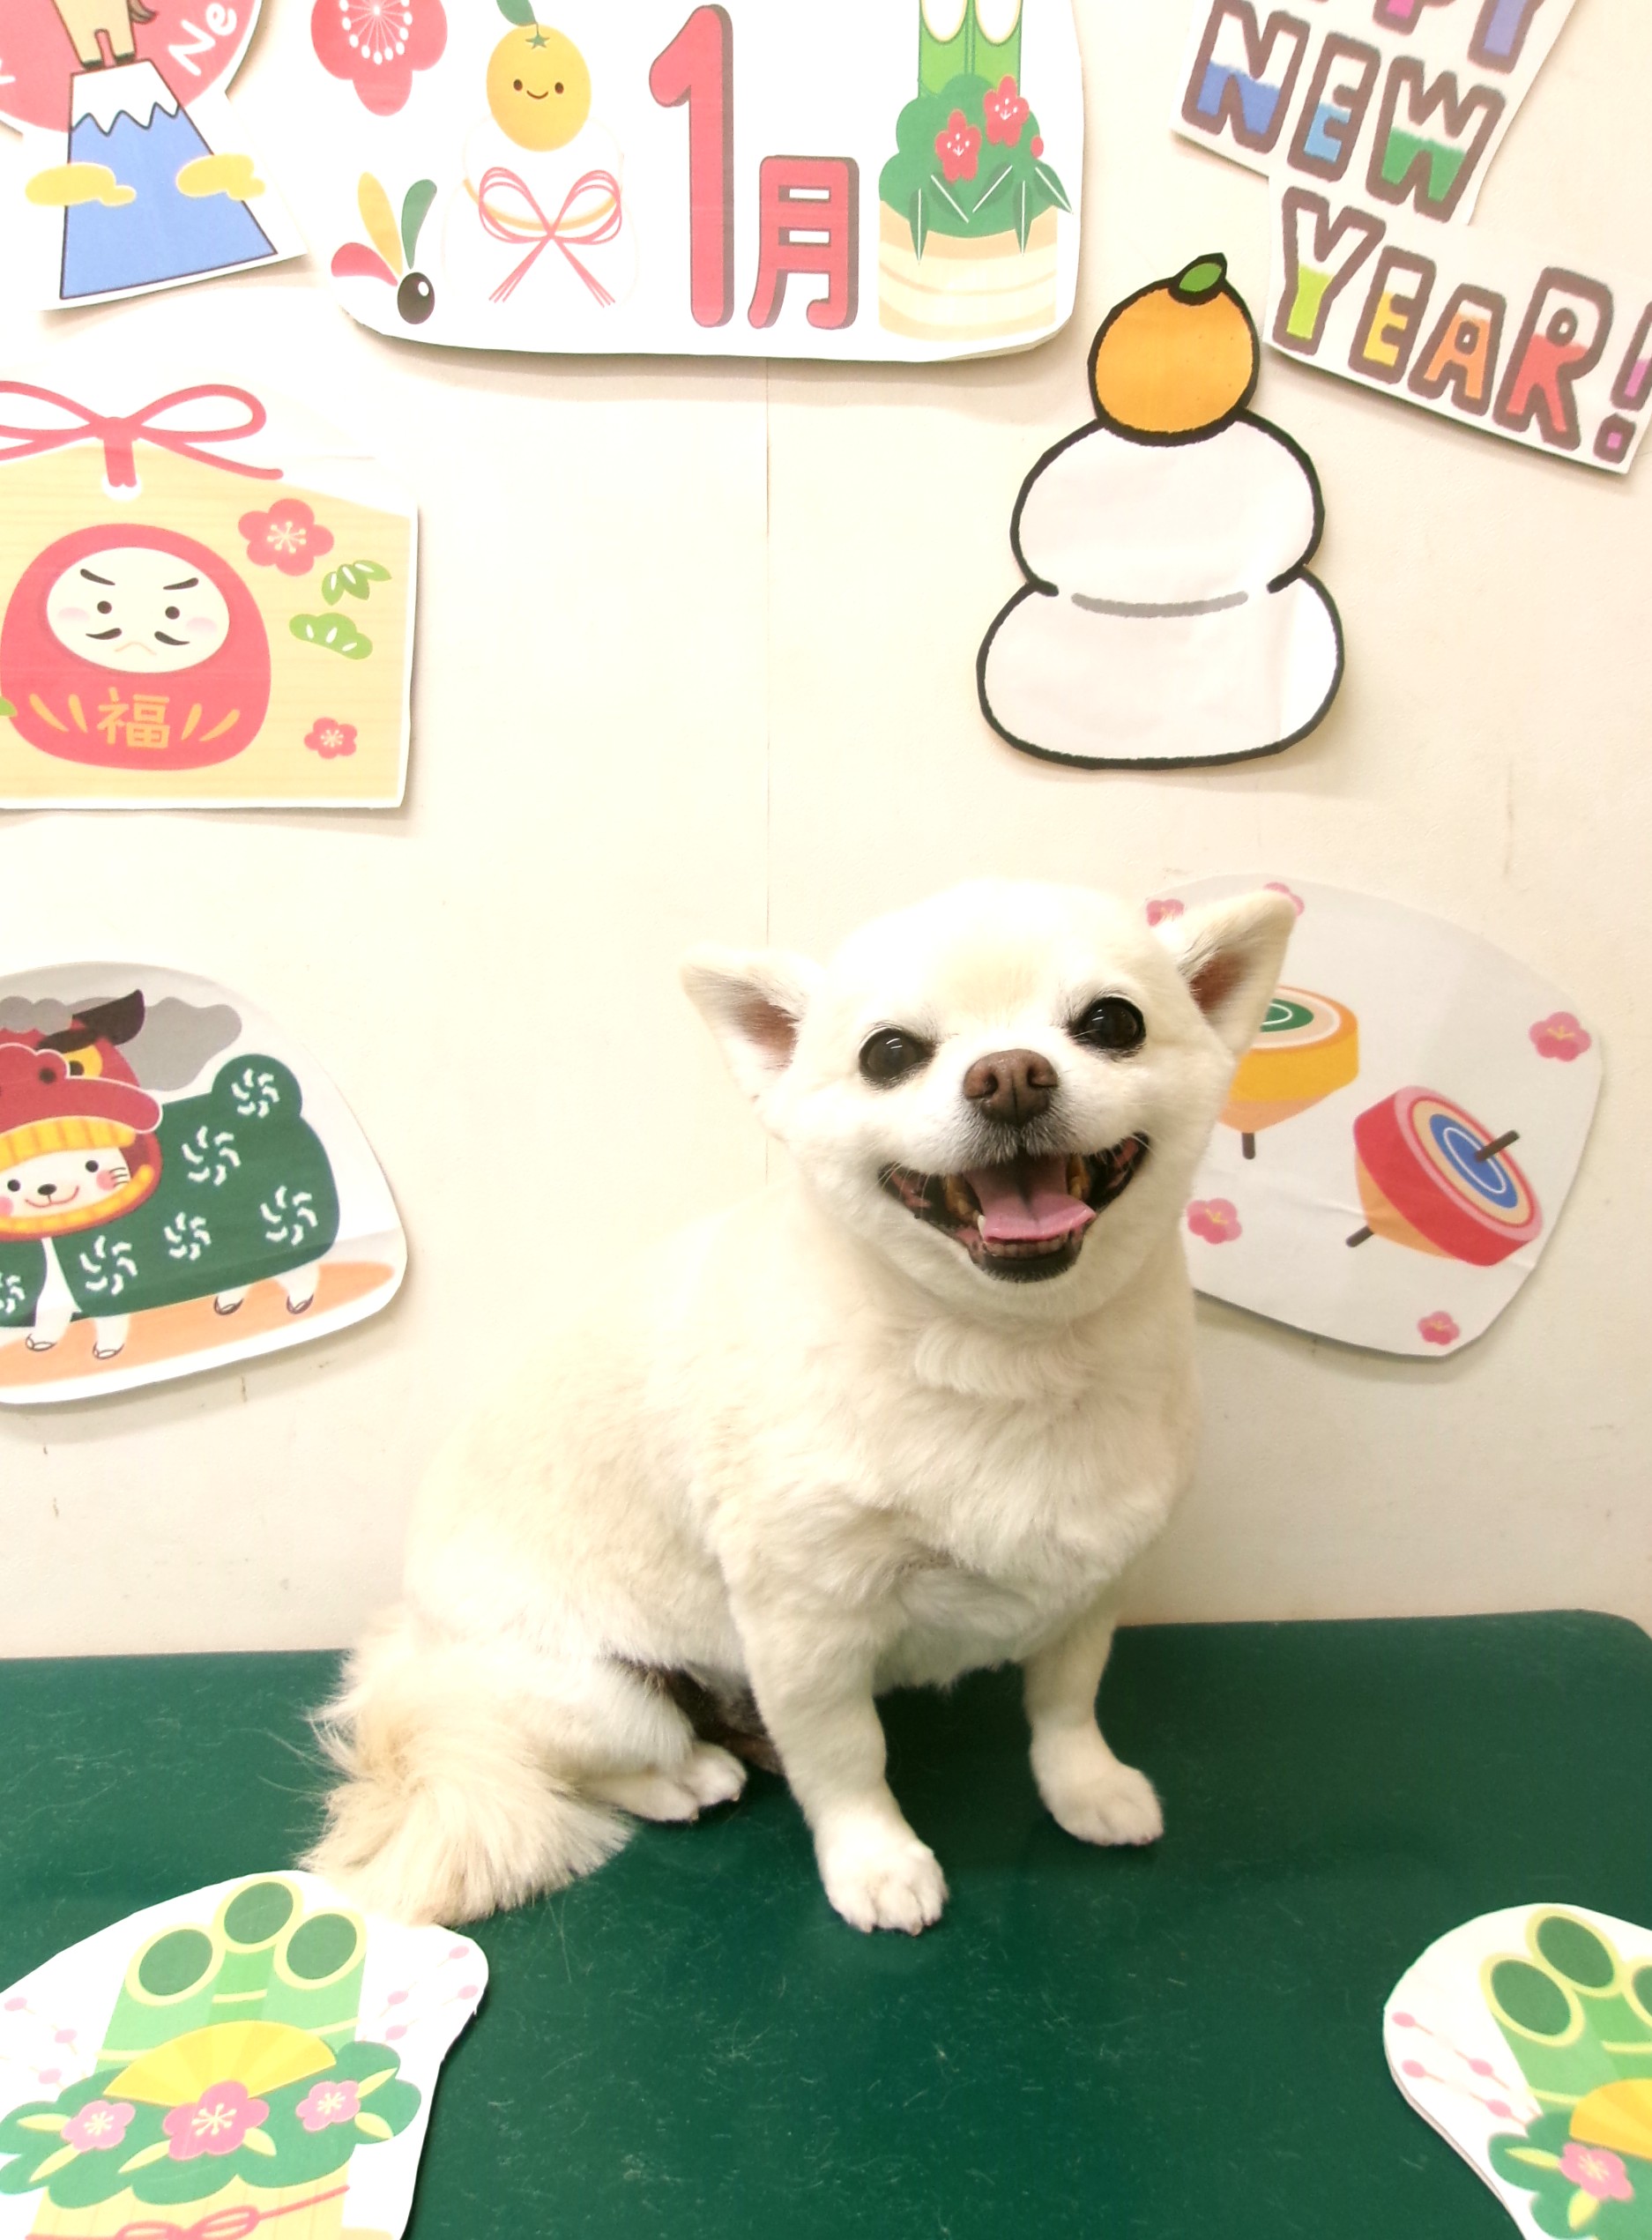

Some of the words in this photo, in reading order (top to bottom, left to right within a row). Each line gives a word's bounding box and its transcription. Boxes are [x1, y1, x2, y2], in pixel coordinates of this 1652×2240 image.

[649, 4, 859, 331] 1月
[1181, 0, 1507, 223] NEW
[1272, 186, 1652, 464] YEAR!
[97, 686, 170, 749] 福
